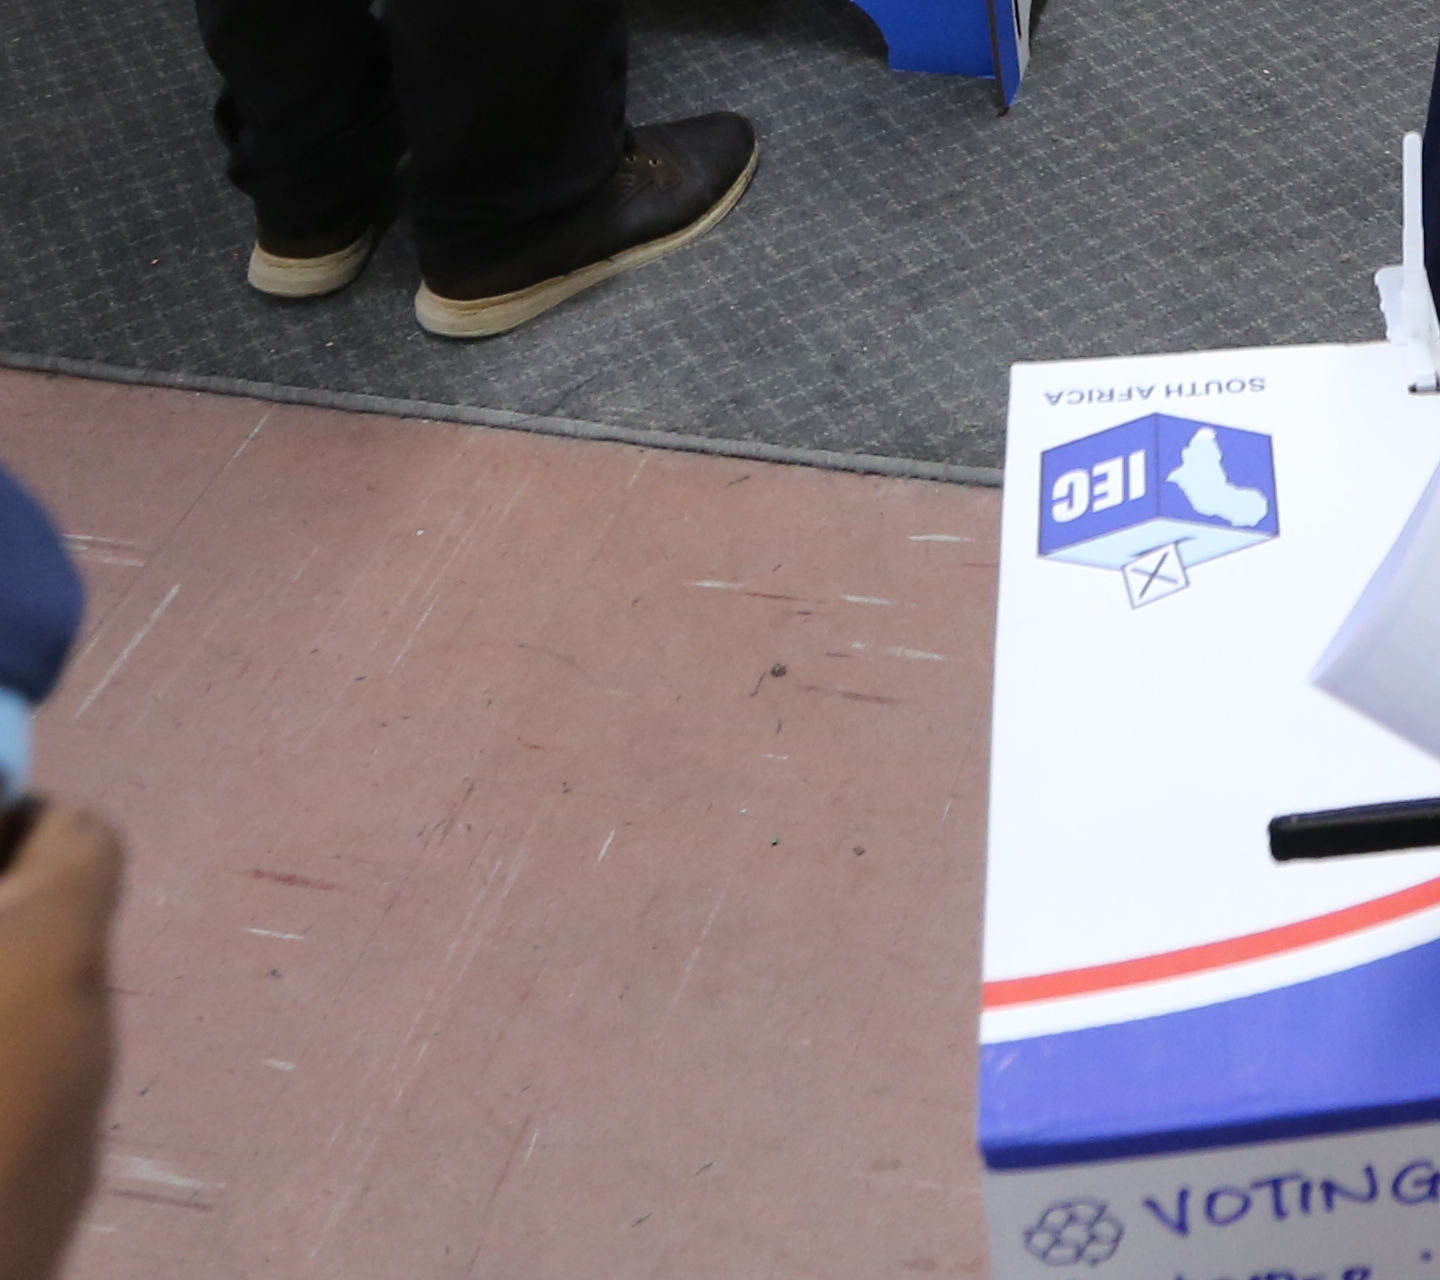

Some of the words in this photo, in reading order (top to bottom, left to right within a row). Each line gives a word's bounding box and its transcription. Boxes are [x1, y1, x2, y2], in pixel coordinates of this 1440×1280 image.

[1045, 384, 1155, 407] AFRICA
[1165, 376, 1266, 399] SOUTH
[1052, 449, 1148, 523] IEC
